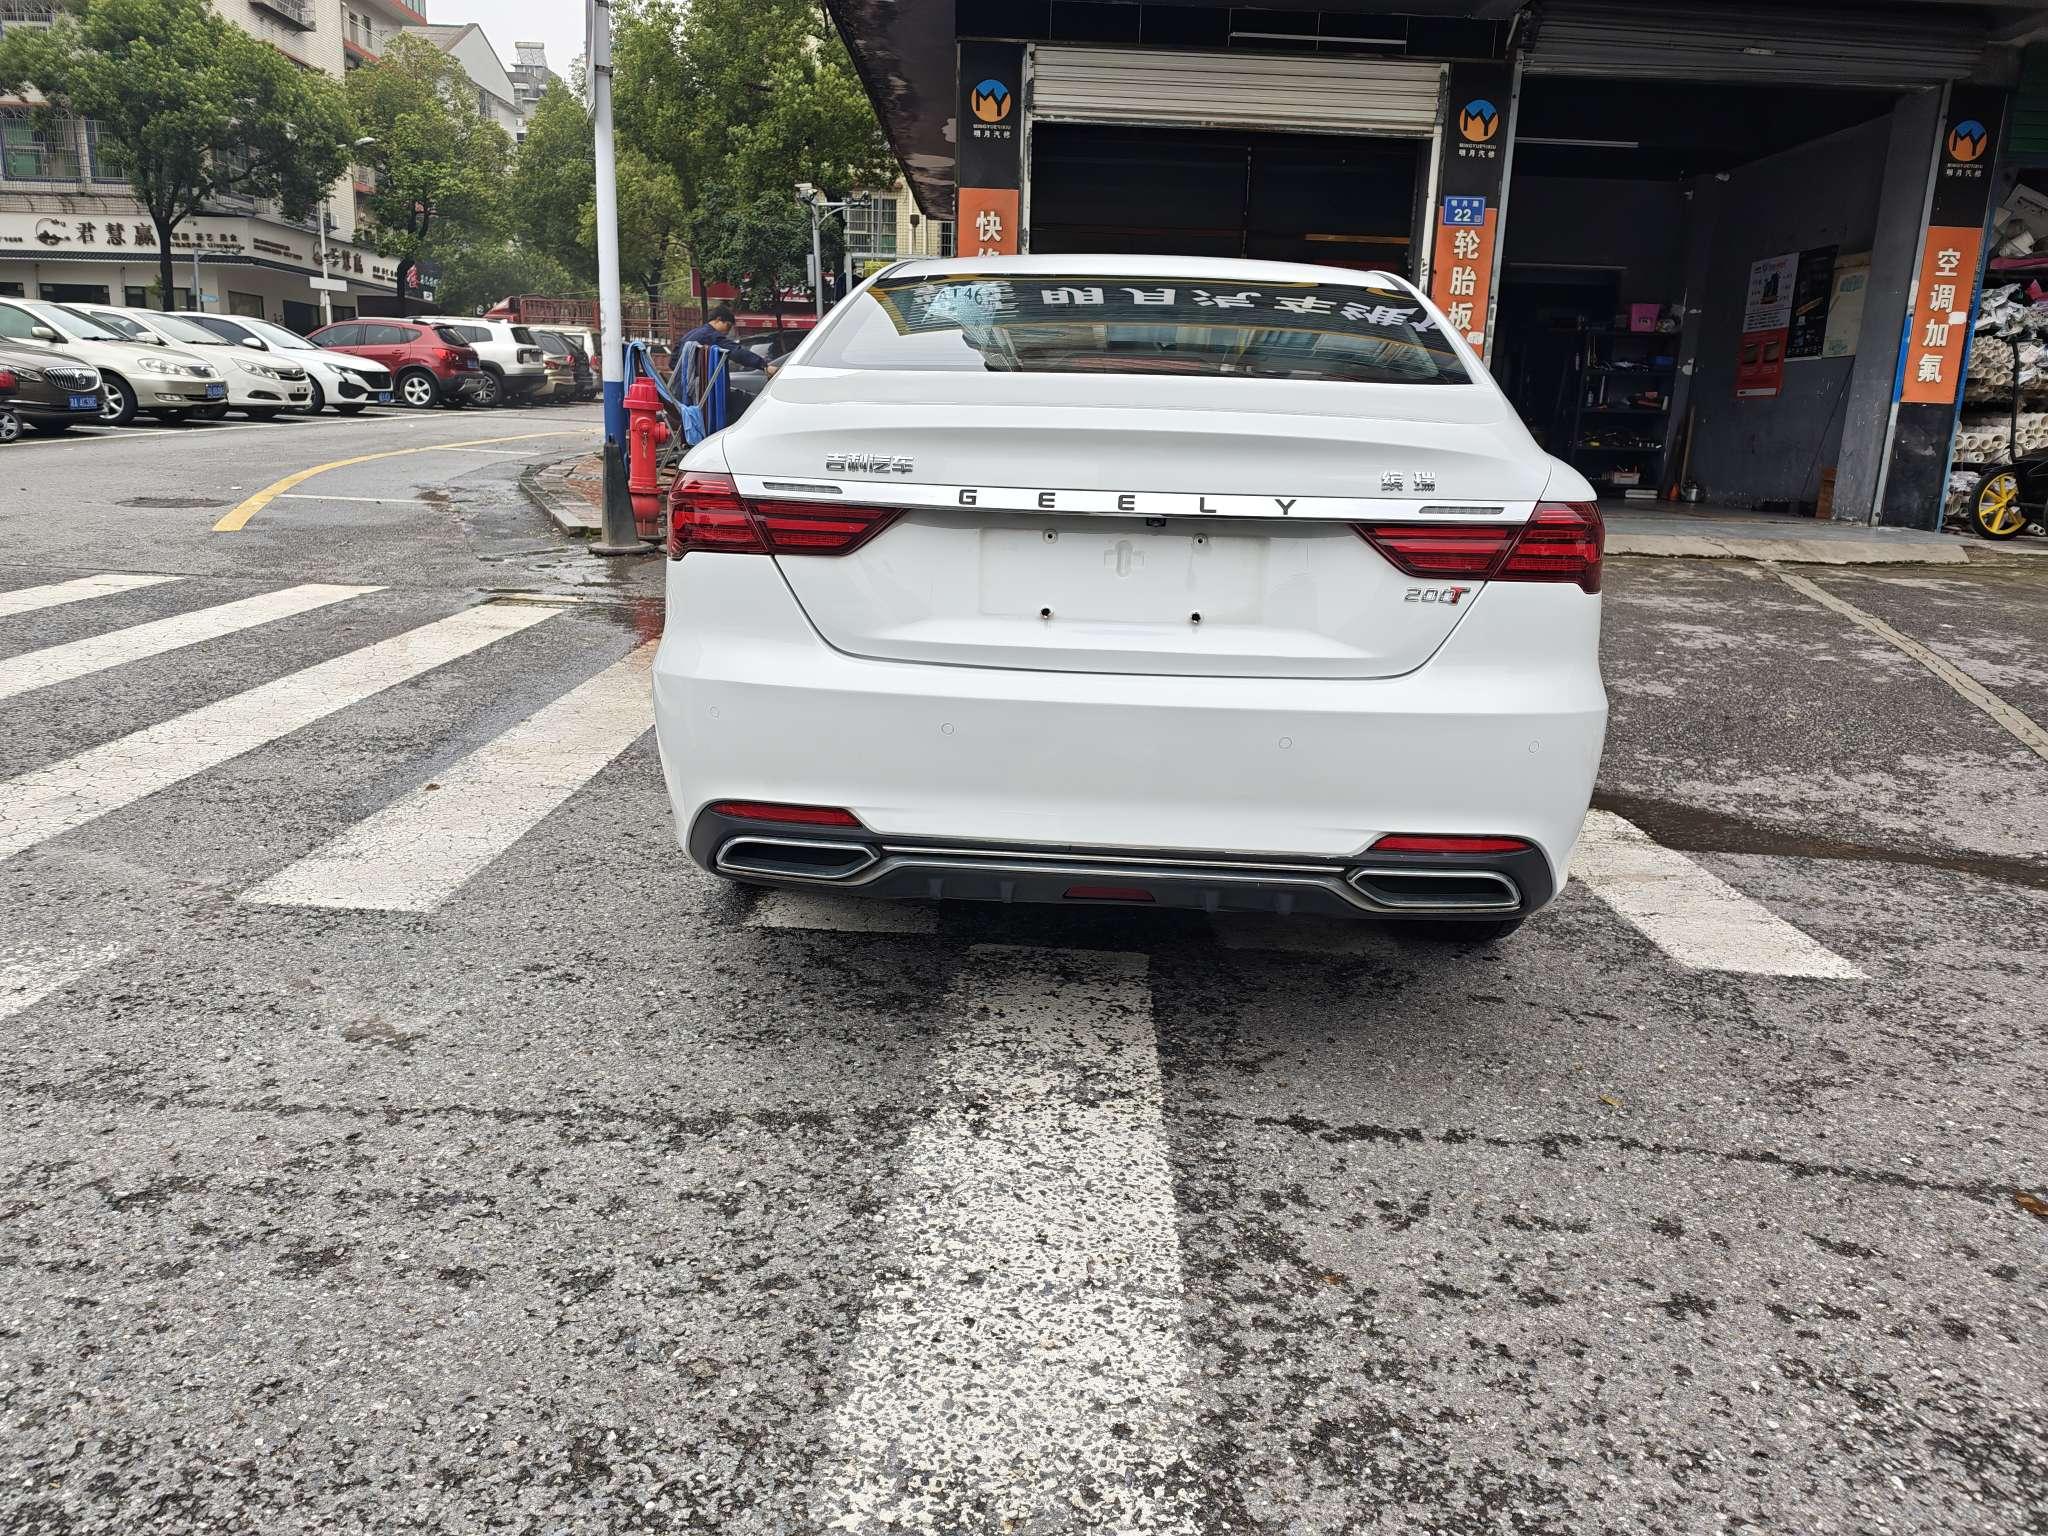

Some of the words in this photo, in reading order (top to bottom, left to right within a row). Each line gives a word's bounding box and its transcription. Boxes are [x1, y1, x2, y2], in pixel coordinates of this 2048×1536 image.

[1454, 208, 1472, 222] 22
[975, 210, 1003, 257] 快
[1917, 248, 1962, 384] 空调加氟
[825, 453, 914, 474] 吉利汽车
[958, 489, 1297, 516] GEELY
[1404, 586, 1472, 605] 200T
